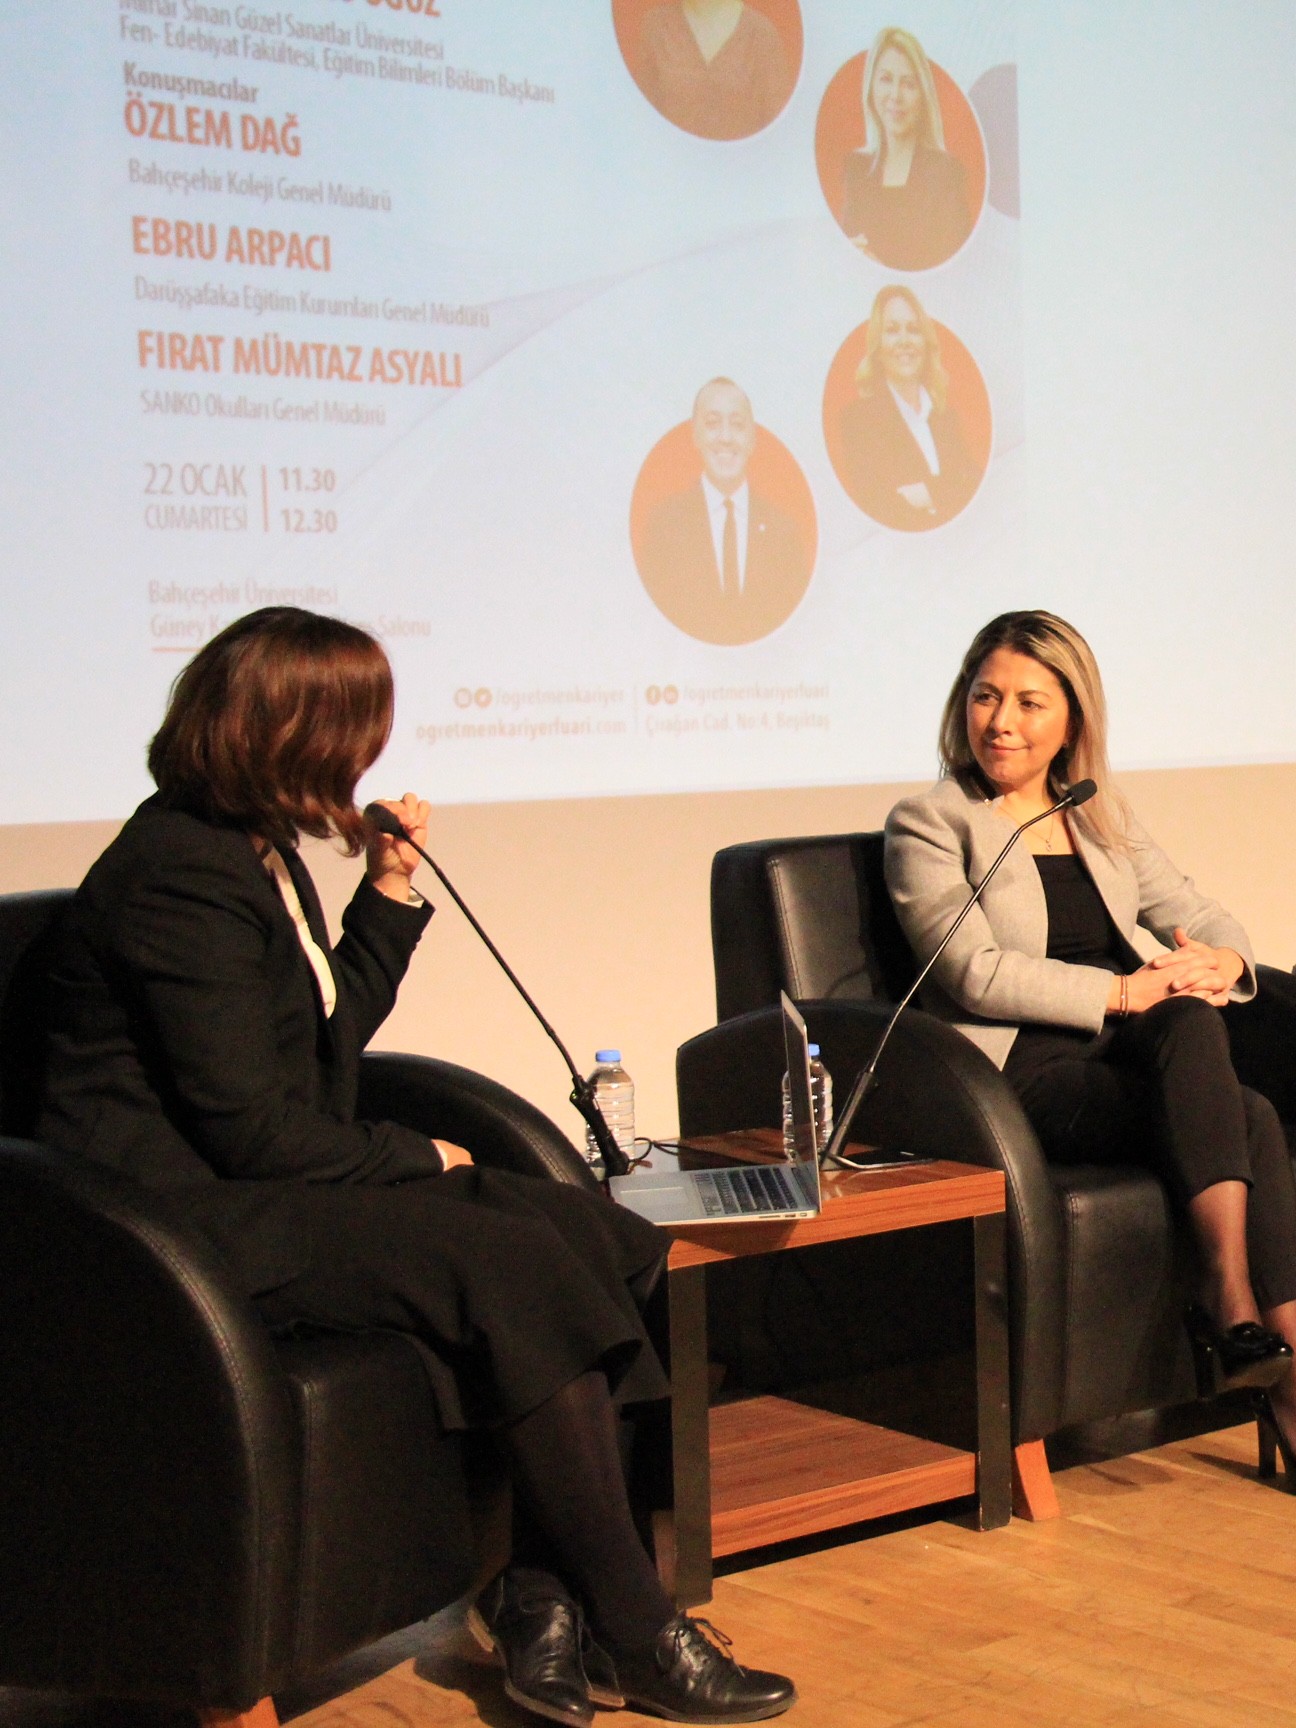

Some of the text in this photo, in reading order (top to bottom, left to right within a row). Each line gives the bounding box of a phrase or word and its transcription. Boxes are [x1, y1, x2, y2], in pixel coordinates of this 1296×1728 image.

[124, 61, 258, 104] Konuşmacılar
[124, 90, 301, 157] ÖZLEM DAĞ
[278, 176, 324, 204] Genel
[132, 215, 331, 272] EBRU ARPACI
[138, 329, 463, 387] FIRAT MÜMTAZ ASYALI
[144, 462, 247, 497] 22 OCAK
[279, 466, 336, 492] 11.30
[281, 508, 337, 533] 12.30
